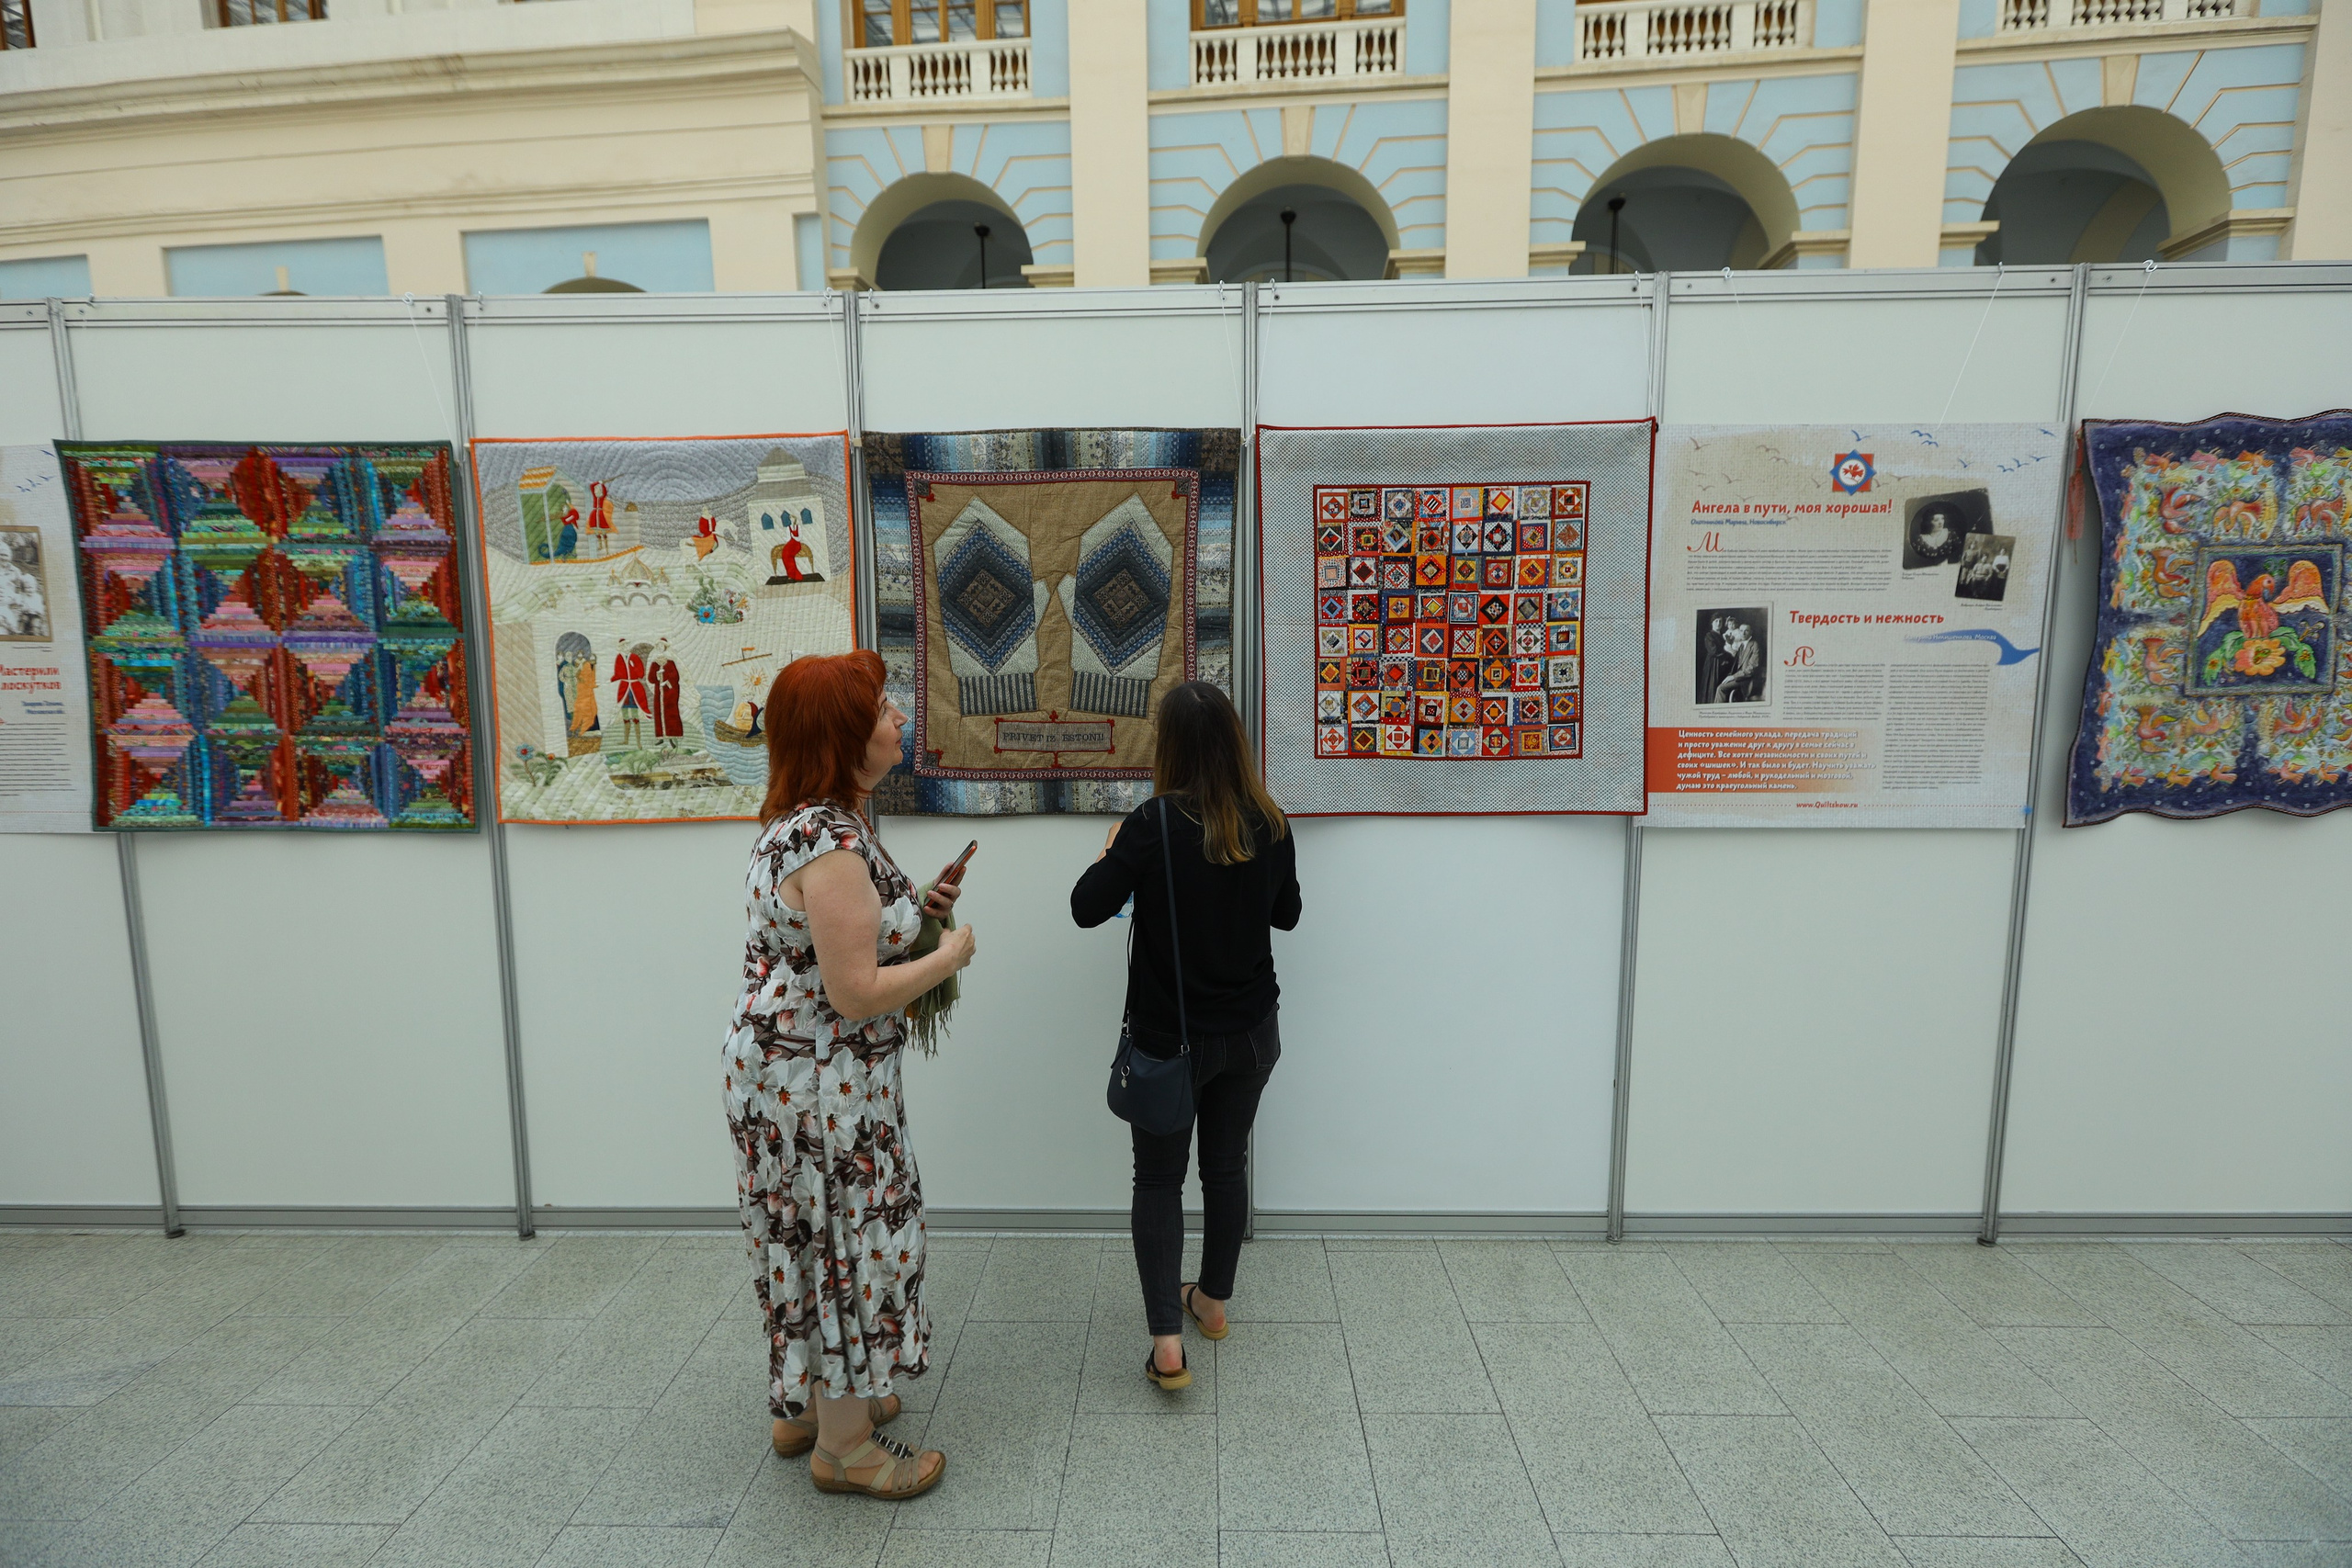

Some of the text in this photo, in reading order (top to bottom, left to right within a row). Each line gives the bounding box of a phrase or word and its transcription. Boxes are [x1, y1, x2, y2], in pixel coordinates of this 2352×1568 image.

[1691, 499, 1893, 518] Ангела в пути, моя хорошая!
[1749, 517, 1786, 527] Новосибирск
[1790, 611, 1945, 629] Твердость и нежность
[1002, 732, 1045, 742] PRIVET
[1679, 729, 1714, 739] Ценность
[1755, 731, 1783, 740] уклада,
[1784, 731, 1820, 740] передача
[1821, 730, 1858, 740] традиций
[1684, 741, 1710, 750] просто
[1711, 741, 1747, 750] уважение
[1747, 741, 1766, 751] друг
[1772, 741, 1795, 750] другу
[1678, 750, 1716, 761] дефиците.
[1838, 750, 1860, 761] путей
[1740, 761, 1747, 769] И
[1761, 761, 1781, 769] было
[1788, 761, 1811, 771] будет.
[1812, 761, 1845, 771] Научить
[1845, 763, 1877, 772] уважать
[1677, 772, 1702, 781] чужой
[1702, 773, 1721, 782] труд
[1728, 771, 1753, 779] любой,
[1760, 772, 1810, 781] рукодельный
[1676, 783, 1702, 791] думаю
[1716, 782, 1768, 792] краеугольный
